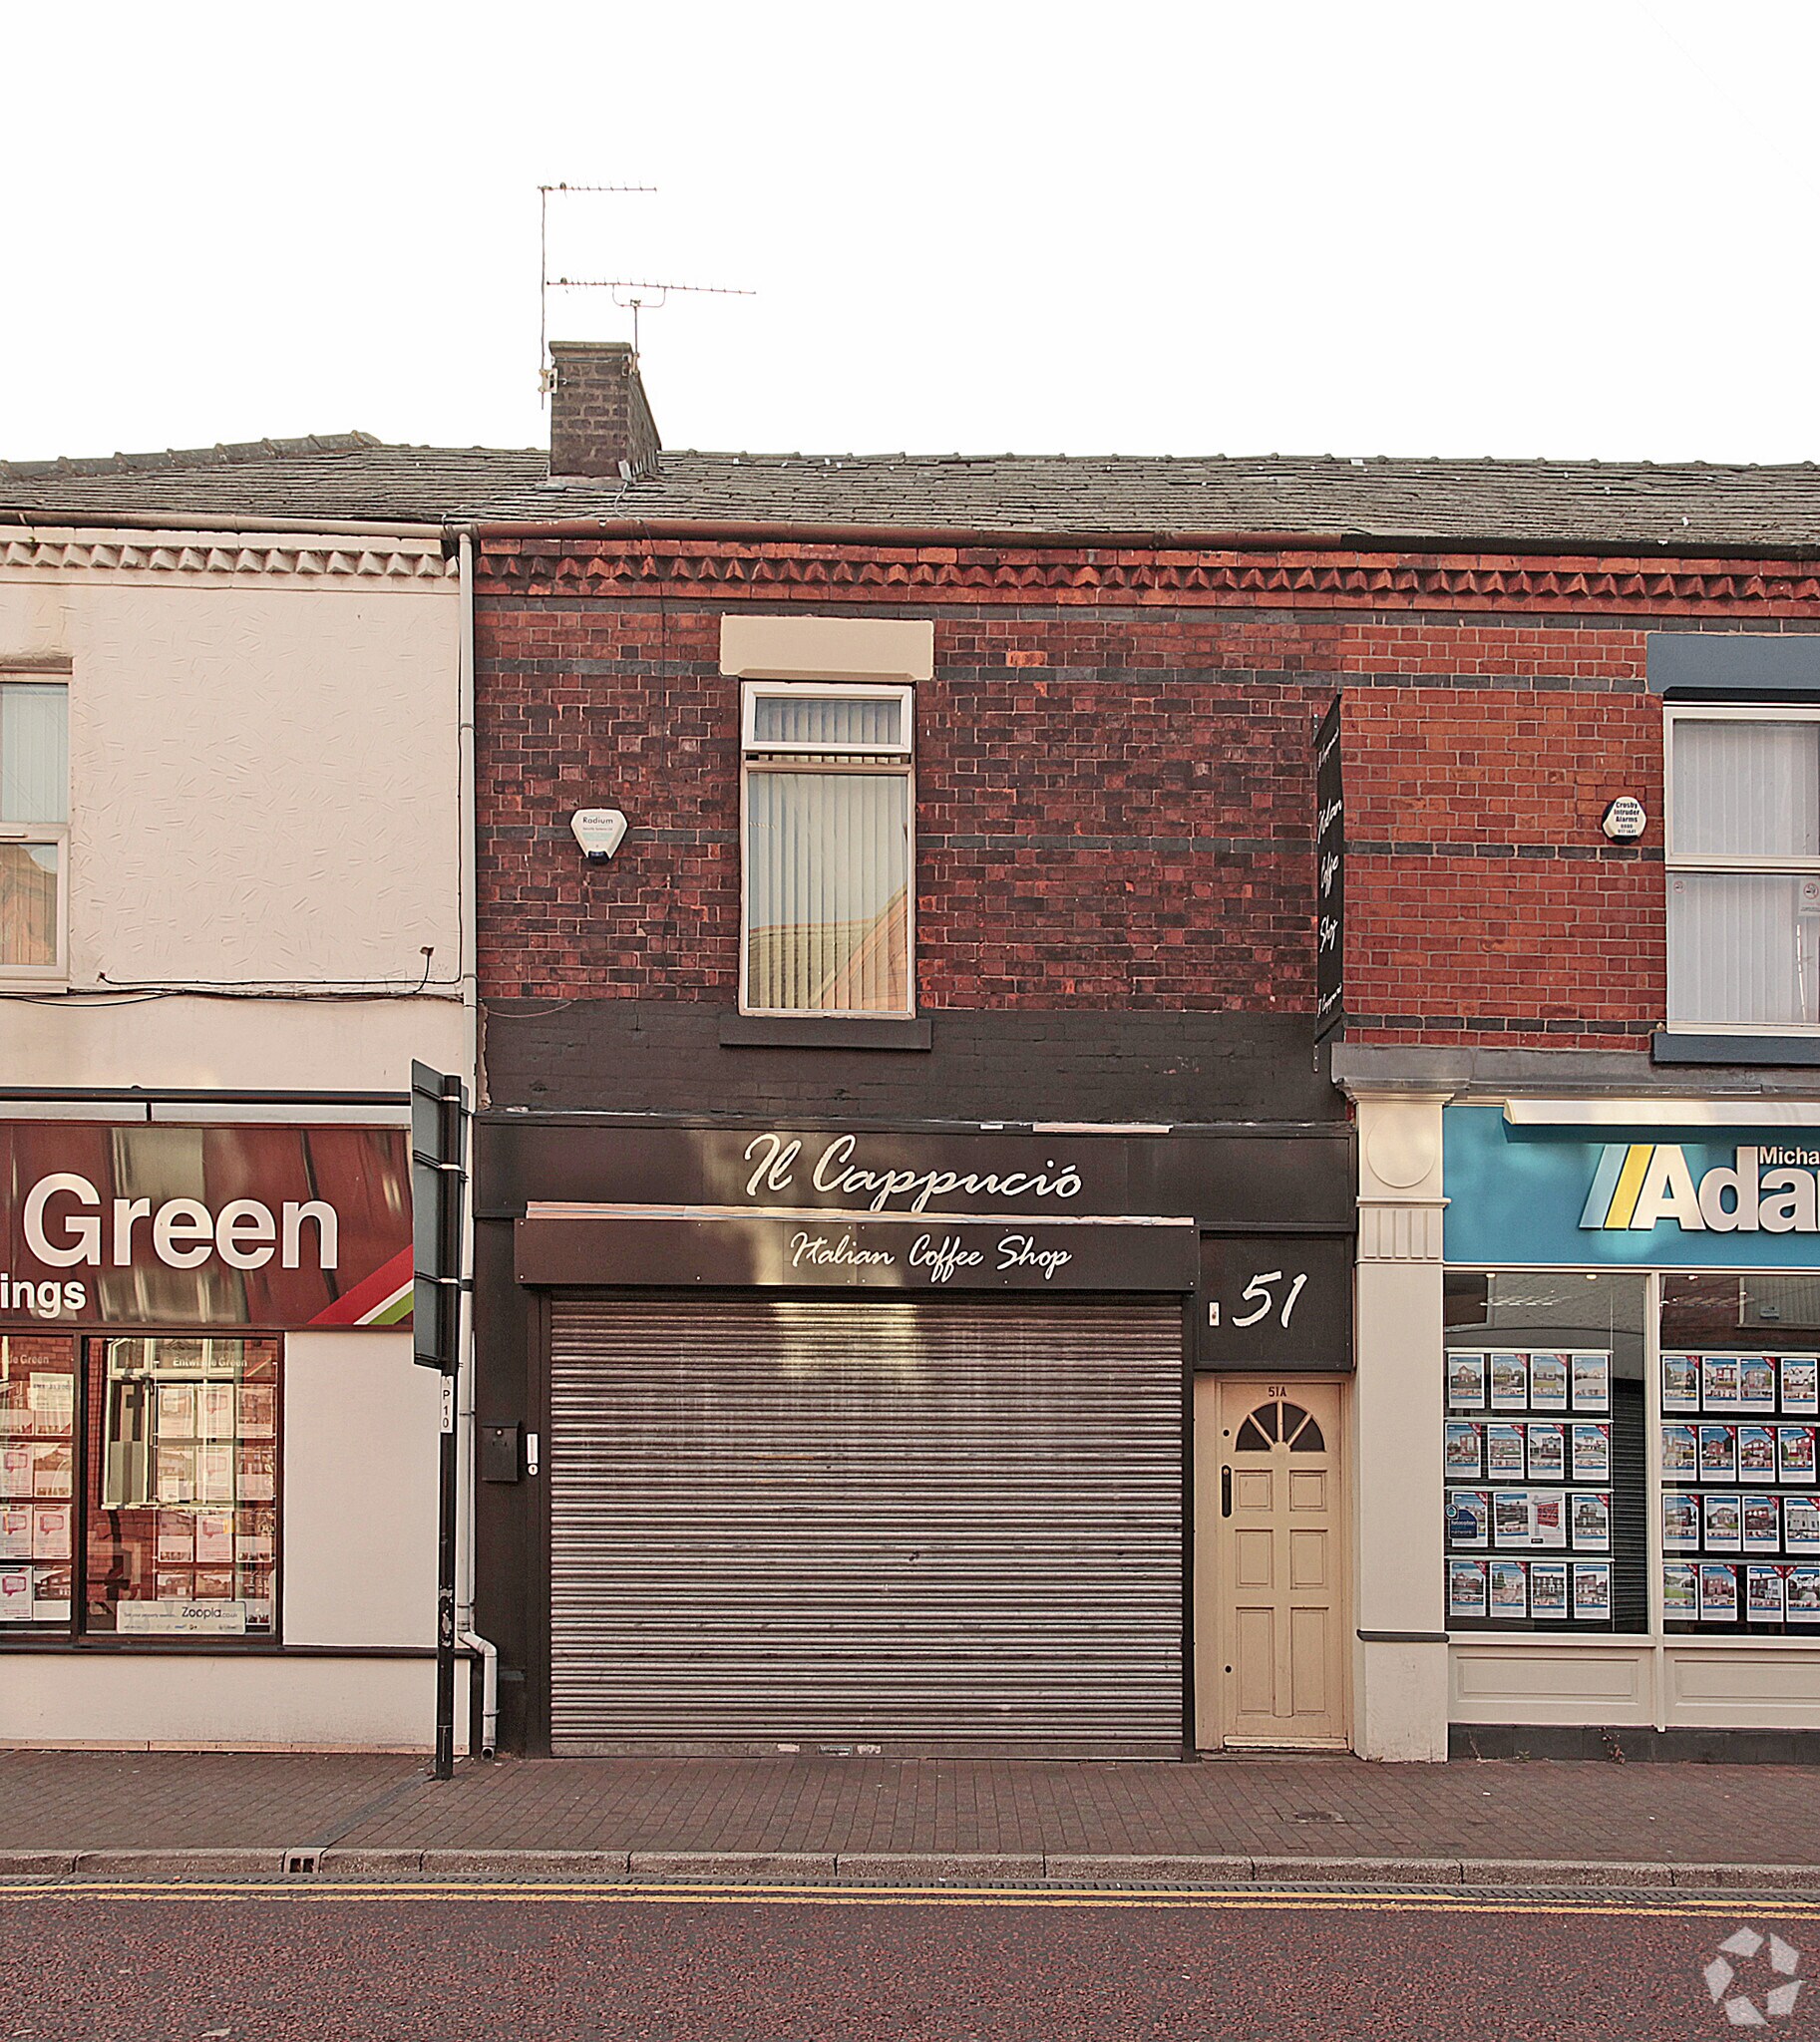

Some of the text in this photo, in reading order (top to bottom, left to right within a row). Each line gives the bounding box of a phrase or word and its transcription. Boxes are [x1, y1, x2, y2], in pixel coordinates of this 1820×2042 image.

[813, 1134, 1082, 1213] Cappució
[1629, 1144, 1820, 1233] Ada
[23, 1172, 339, 1270] Green
[790, 1231, 1073, 1283] Italian Coffee Shop
[0, 1272, 87, 1319] ings
[1231, 1269, 1308, 1329] 51
[173, 1356, 217, 1367] Entwise
[1268, 1386, 1287, 1398] 51A
